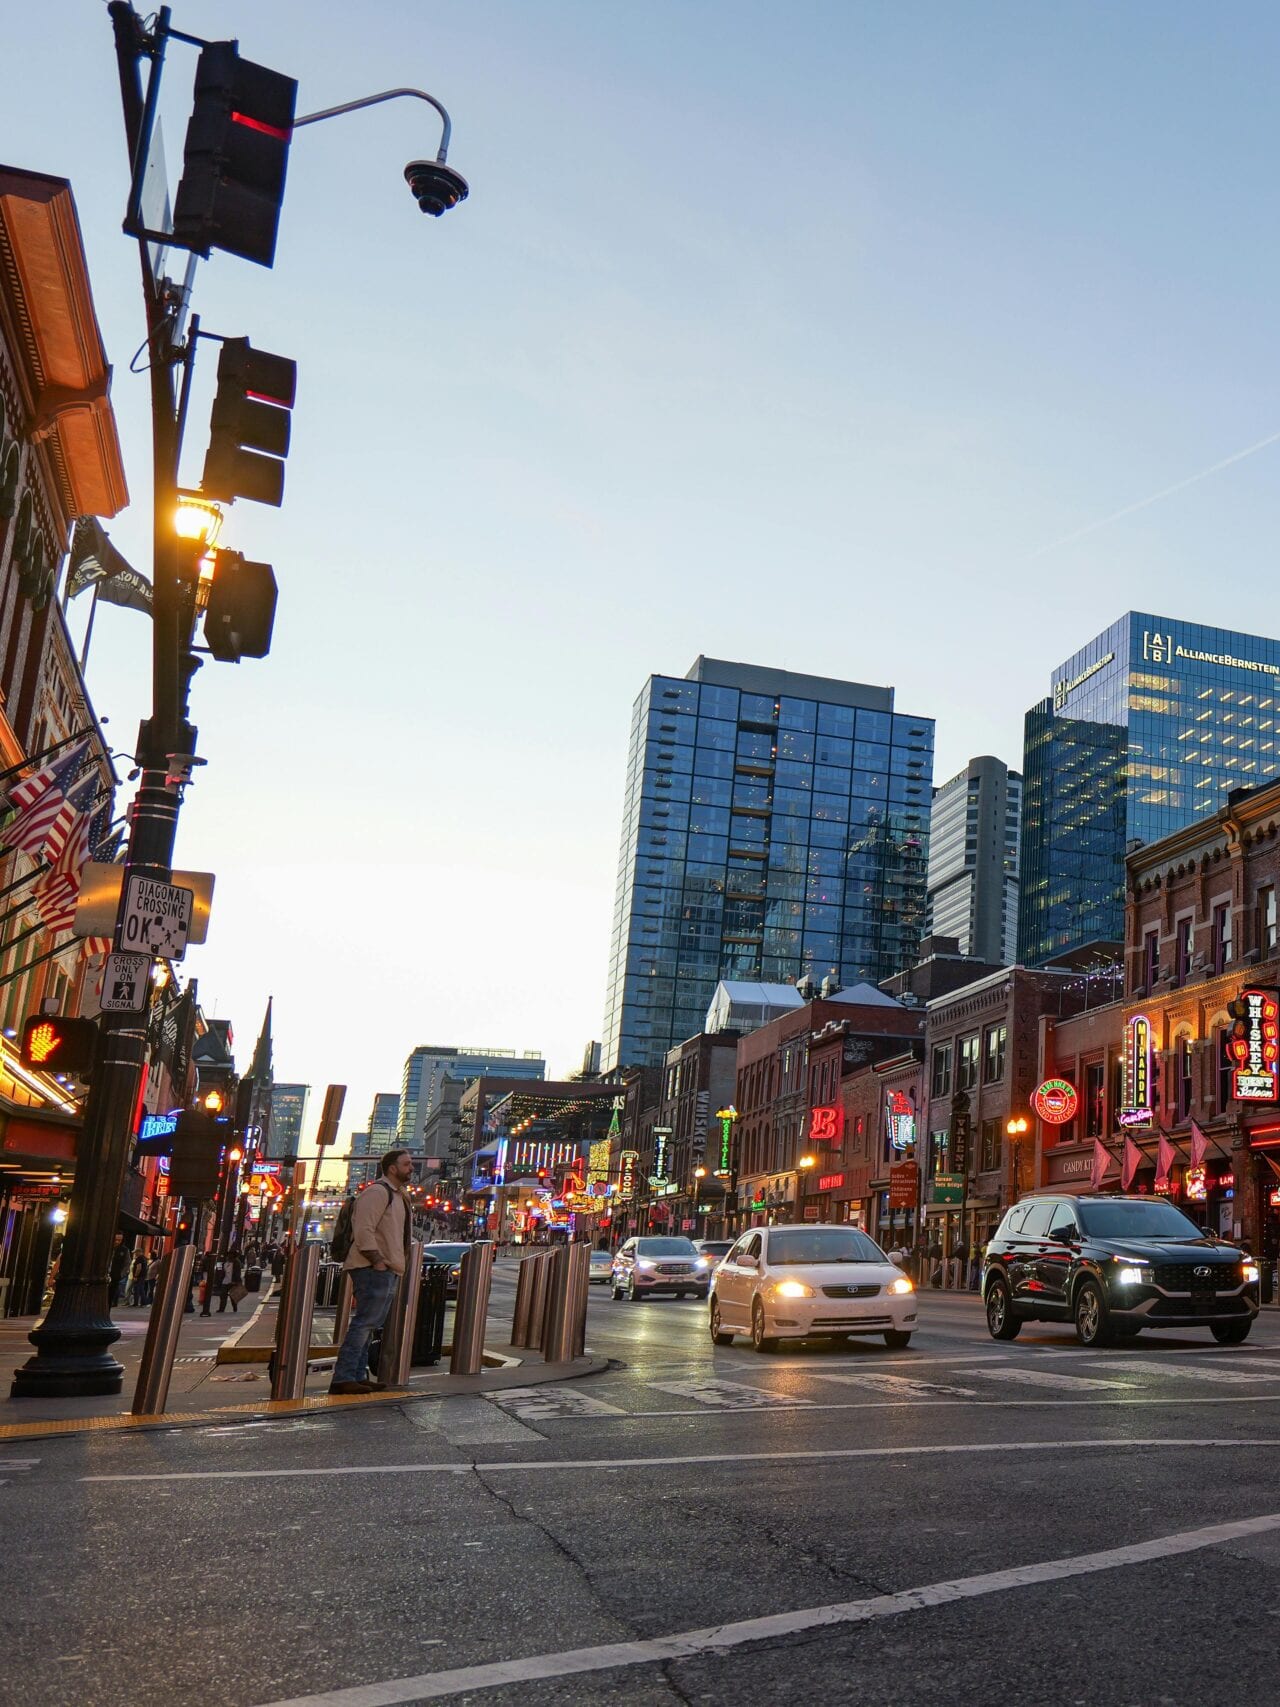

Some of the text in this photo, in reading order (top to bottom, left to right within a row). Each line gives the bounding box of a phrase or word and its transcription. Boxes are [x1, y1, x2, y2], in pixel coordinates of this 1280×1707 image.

[1175, 645, 1280, 675] ALLIANCEBERNSTEIN
[138, 880, 187, 905] DIAGONAL
[136, 896, 185, 920] CROSSING
[126, 914, 153, 944] OK
[113, 956, 144, 966] CROSS
[115, 965, 140, 974] ONLY
[120, 973, 133, 982] ON
[106, 1000, 136, 1009] SIGNAL
[1247, 994, 1264, 1075] WHISKEY
[1138, 1023, 1146, 1104] MIRANDA
[692, 1090, 710, 1153] WHISKEY
[810, 1107, 838, 1139] B
[622, 1157, 634, 1193] SALOON
[1063, 1160, 1084, 1173] CANDY
